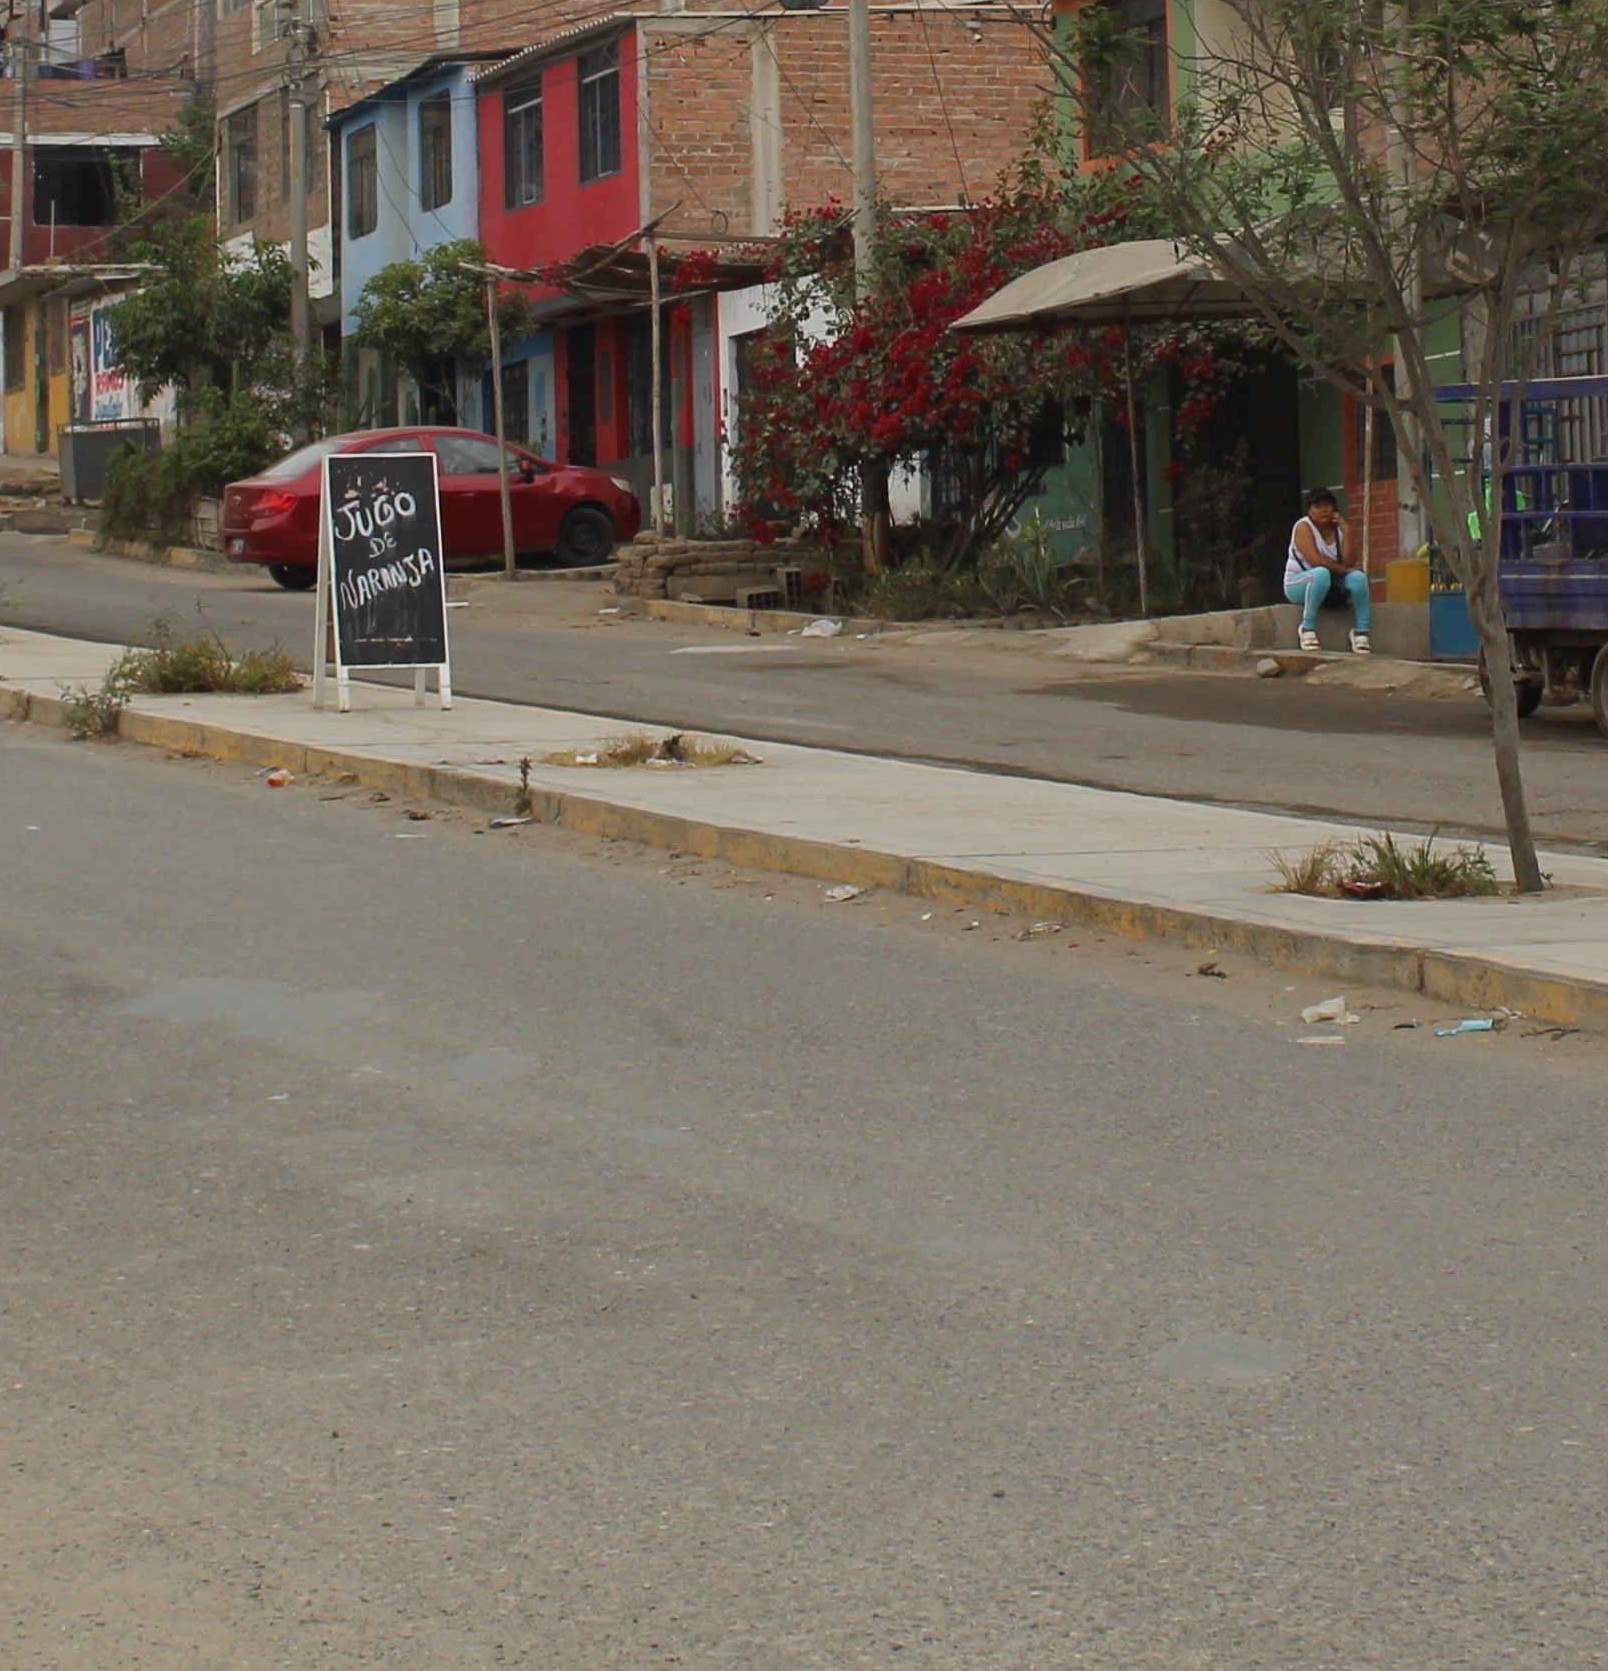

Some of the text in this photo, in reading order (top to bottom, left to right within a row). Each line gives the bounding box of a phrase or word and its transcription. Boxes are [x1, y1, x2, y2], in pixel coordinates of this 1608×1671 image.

[334, 492, 416, 541] JUGO
[368, 532, 397, 559] DE
[340, 548, 435, 611] NARANJA
